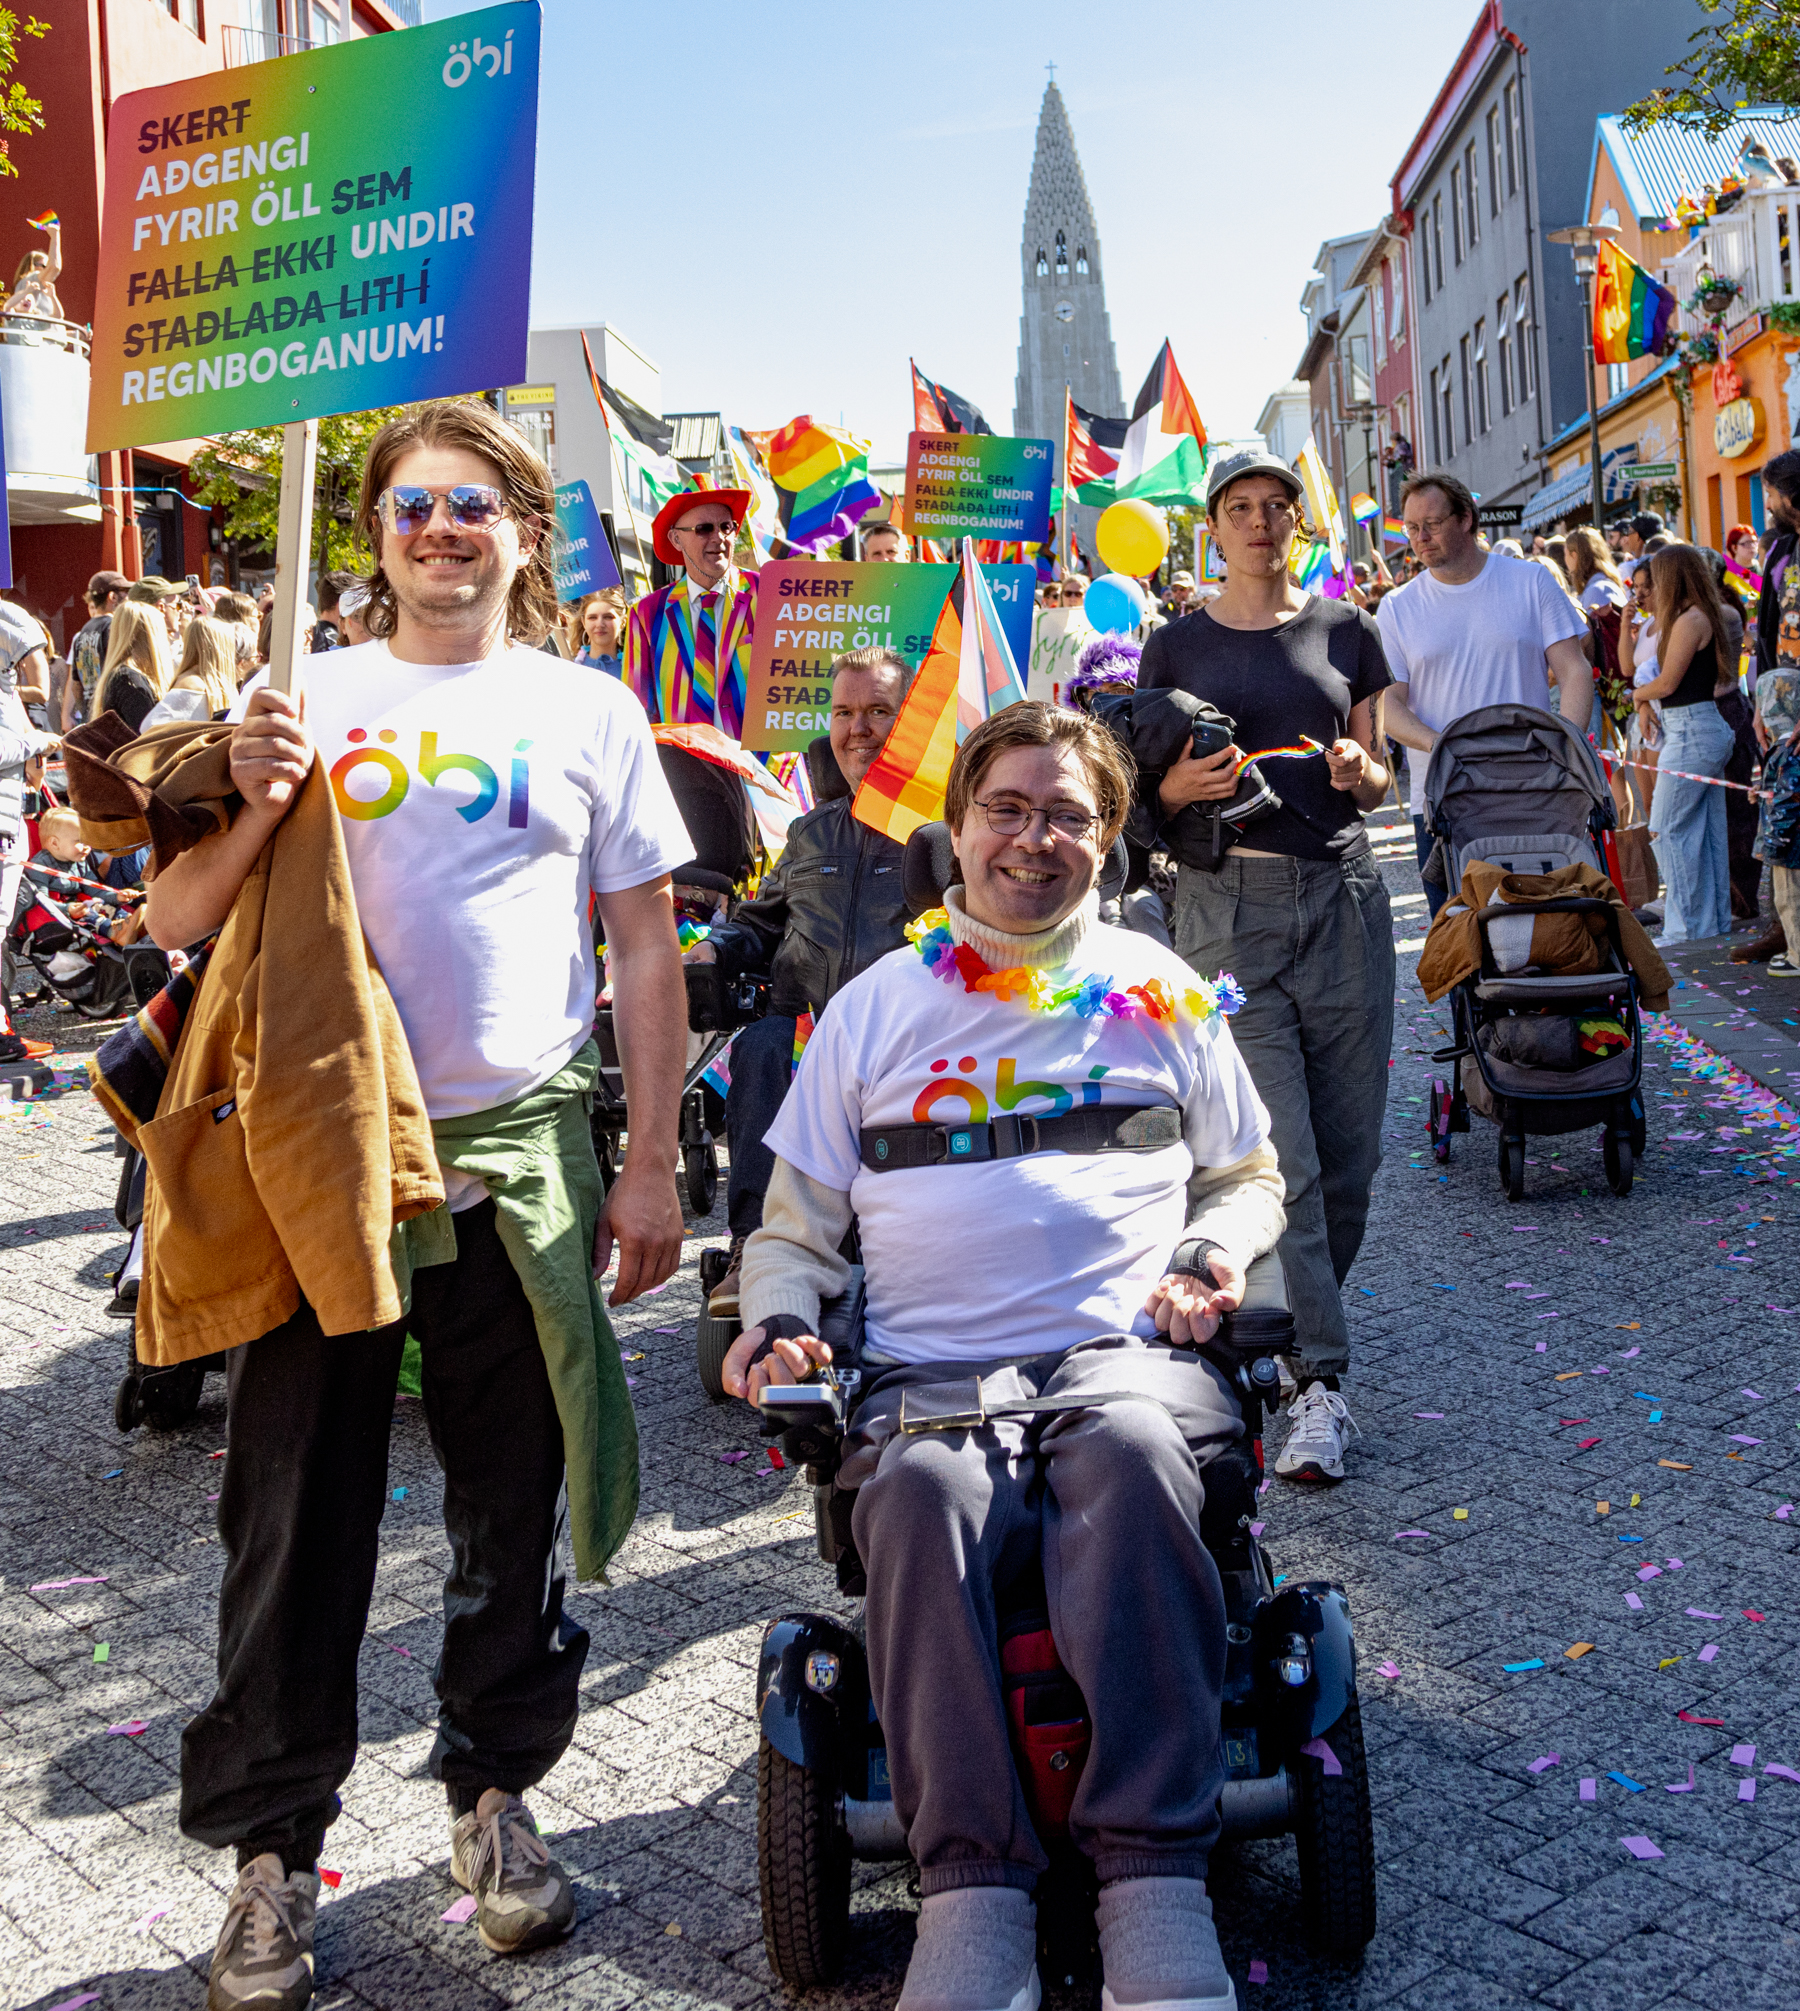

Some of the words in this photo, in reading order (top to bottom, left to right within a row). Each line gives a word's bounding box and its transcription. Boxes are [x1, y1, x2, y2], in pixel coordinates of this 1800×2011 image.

[138, 98, 251, 154] SKERT
[135, 131, 310, 201] AÐGENGI
[133, 199, 240, 252] FYRIR
[251, 180, 321, 227] ÖLL
[331, 165, 413, 215] SEM
[127, 255, 239, 307] FALLA
[251, 234, 337, 284] EKKI
[350, 202, 475, 259] UNDIR
[339, 273, 405, 320] LITI
[418, 257, 431, 305] Í
[121, 315, 446, 406] REGNBOGANUM!
[919, 440, 959, 452] SKERT
[917, 468, 956, 481] FYRIR
[959, 468, 984, 483] ÖLL
[986, 474, 1014, 486] SEM
[916, 484, 955, 497] FALLA
[960, 487, 988, 499] EKKI
[992, 488, 1034, 501] UNDIR
[988, 504, 1011, 516] LITI
[1479, 510, 1517, 522] RASON
[914, 512, 1024, 530] REGNBOGANUM!
[778, 578, 854, 598] SKERT
[776, 603, 891, 623] AÐGENGI
[774, 630, 845, 650] FYRIR
[852, 626, 897, 651] ÖLL
[903, 634, 932, 653] SE
[766, 685, 831, 706] STAÐ
